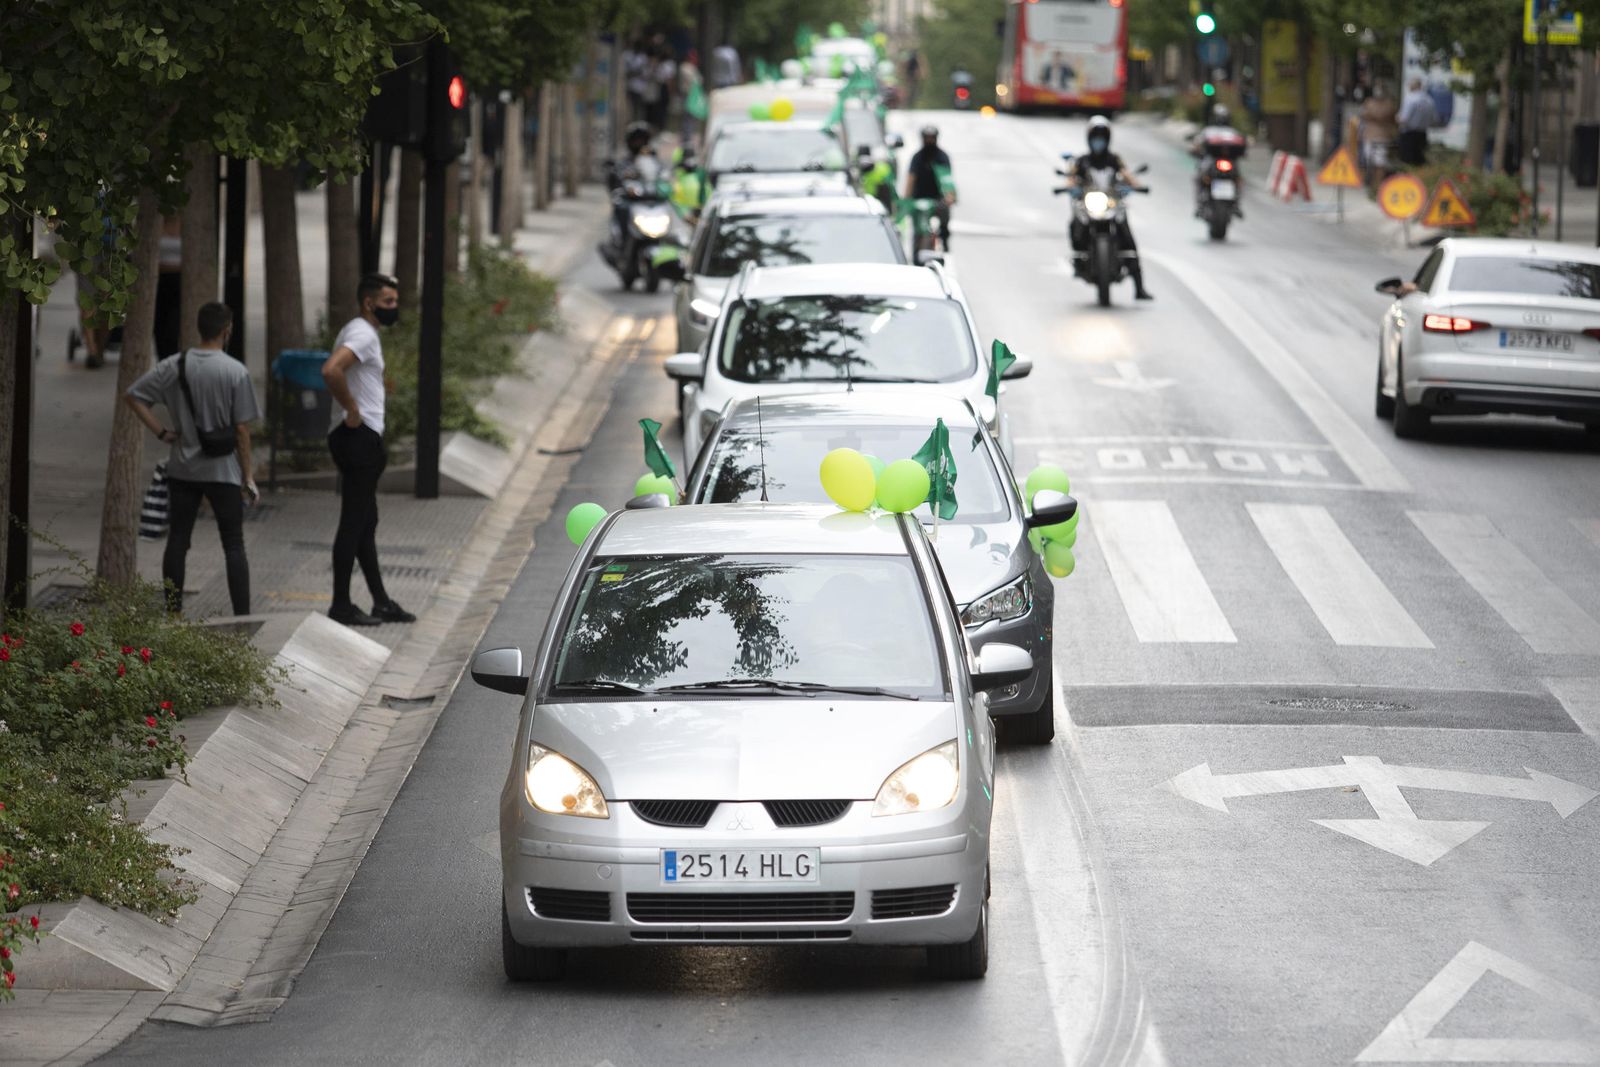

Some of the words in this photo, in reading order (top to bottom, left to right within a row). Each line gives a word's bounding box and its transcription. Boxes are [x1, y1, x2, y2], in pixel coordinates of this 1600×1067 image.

[667, 869, 674, 877] E
[680, 853, 749, 878] 2514
[760, 853, 811, 878] HLG
